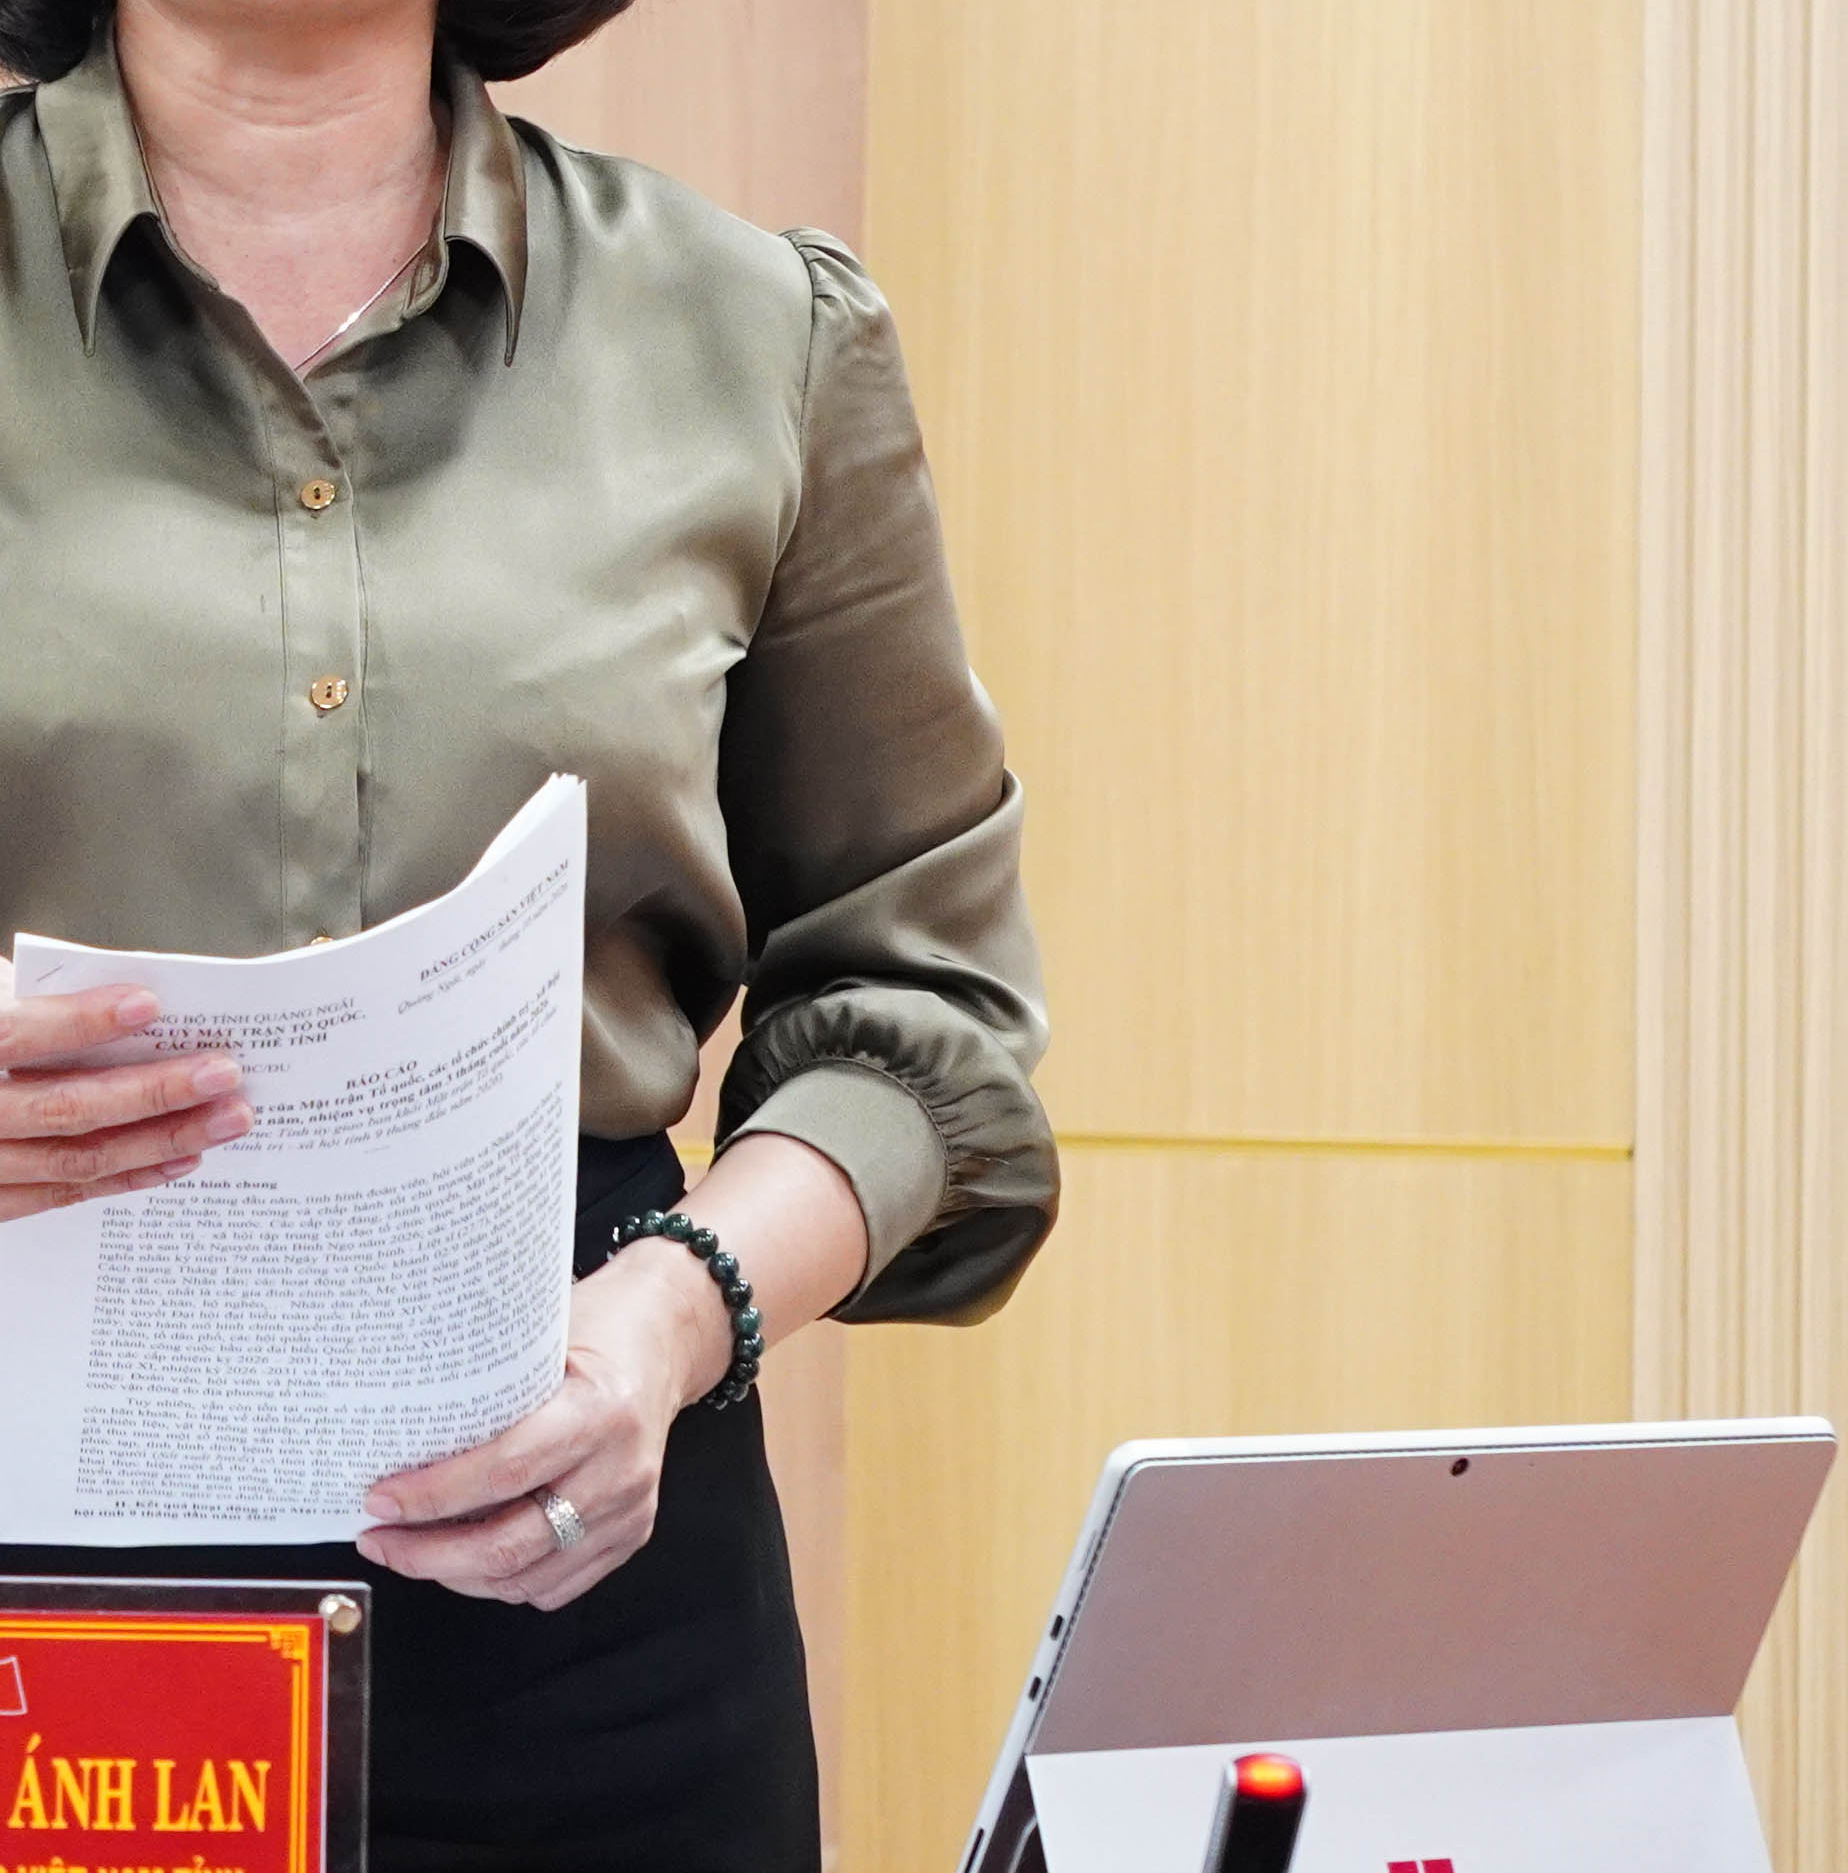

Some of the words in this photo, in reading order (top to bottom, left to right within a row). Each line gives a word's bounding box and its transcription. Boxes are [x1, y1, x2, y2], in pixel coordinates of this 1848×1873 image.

[346, 1073, 380, 1090] BÁO
[384, 1060, 417, 1081] CÁO
[9, 1735, 136, 1830] ÁNH
[154, 1760, 270, 1831] LAN
